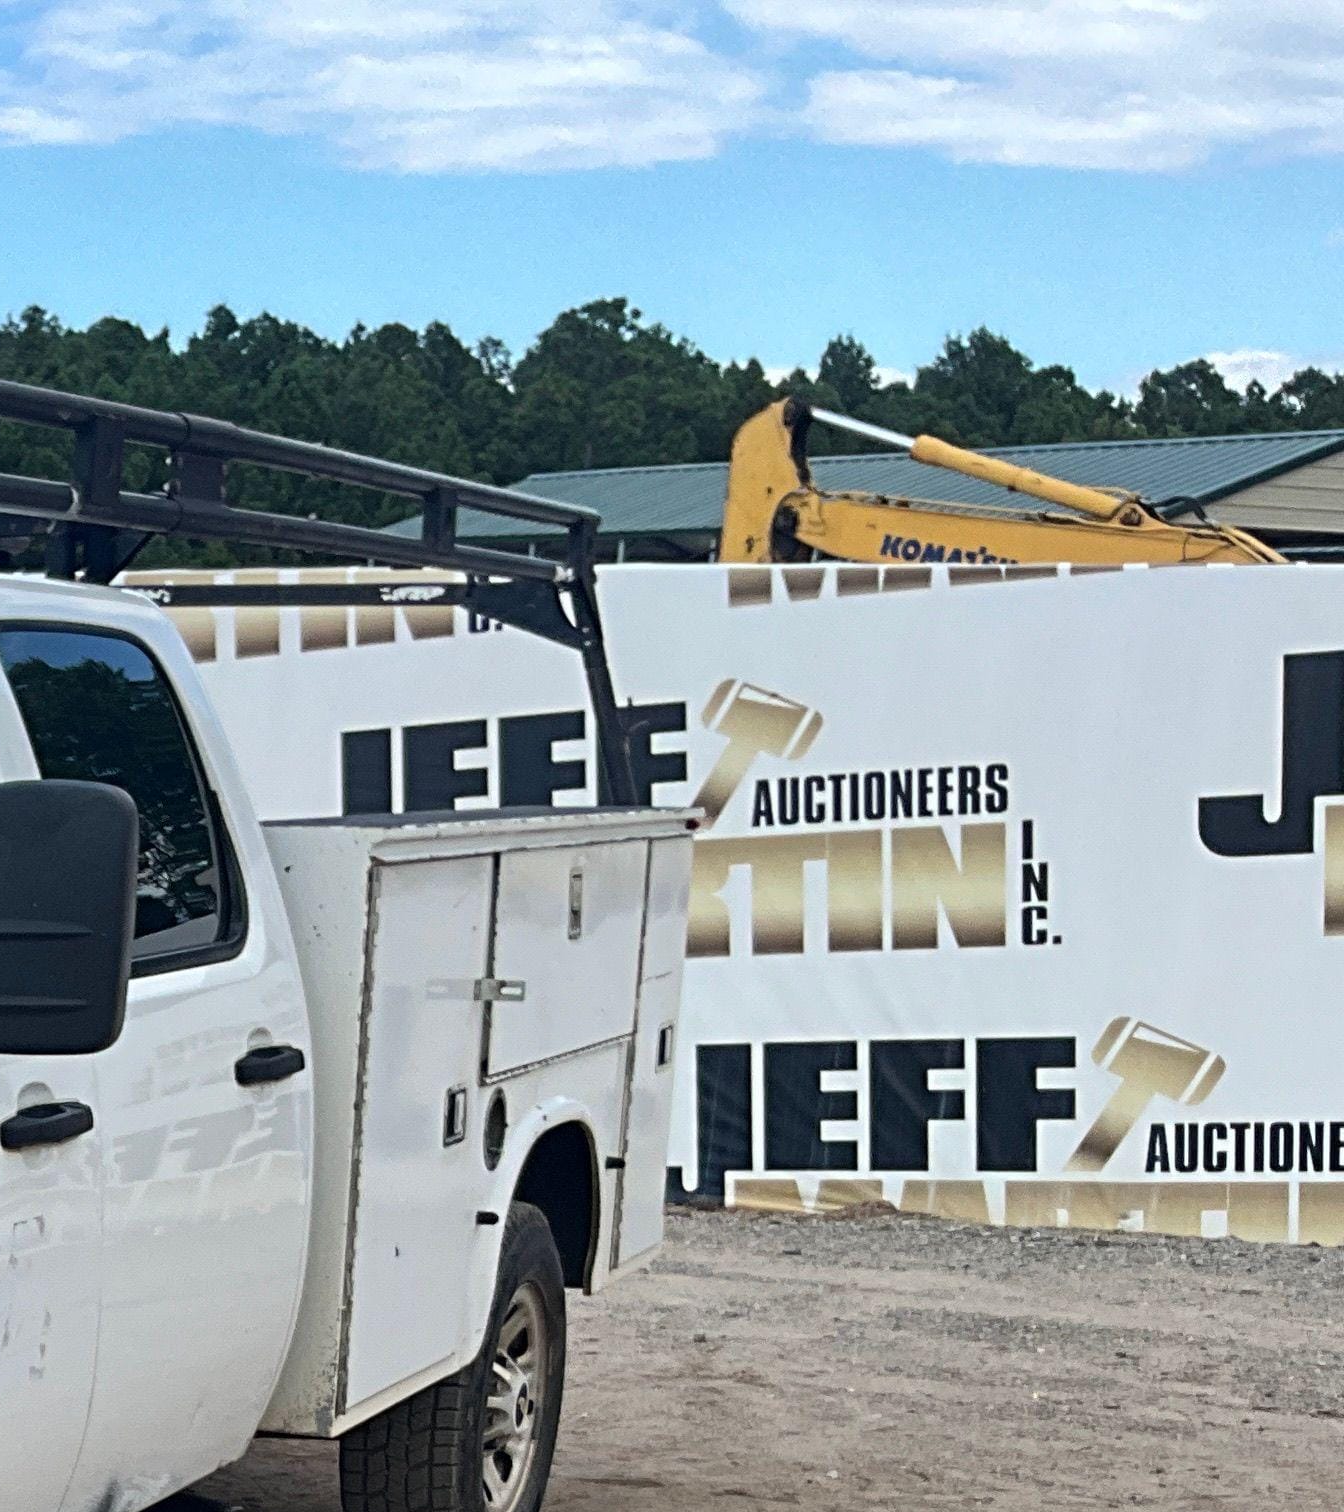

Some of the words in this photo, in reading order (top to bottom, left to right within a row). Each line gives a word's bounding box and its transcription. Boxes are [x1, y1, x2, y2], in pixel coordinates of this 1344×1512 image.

[880, 534, 1018, 563] KOMAT
[752, 763, 1009, 828] AUCTIONEERS
[685, 822, 1006, 958] TIN
[666, 1037, 1076, 1206] JEFF
